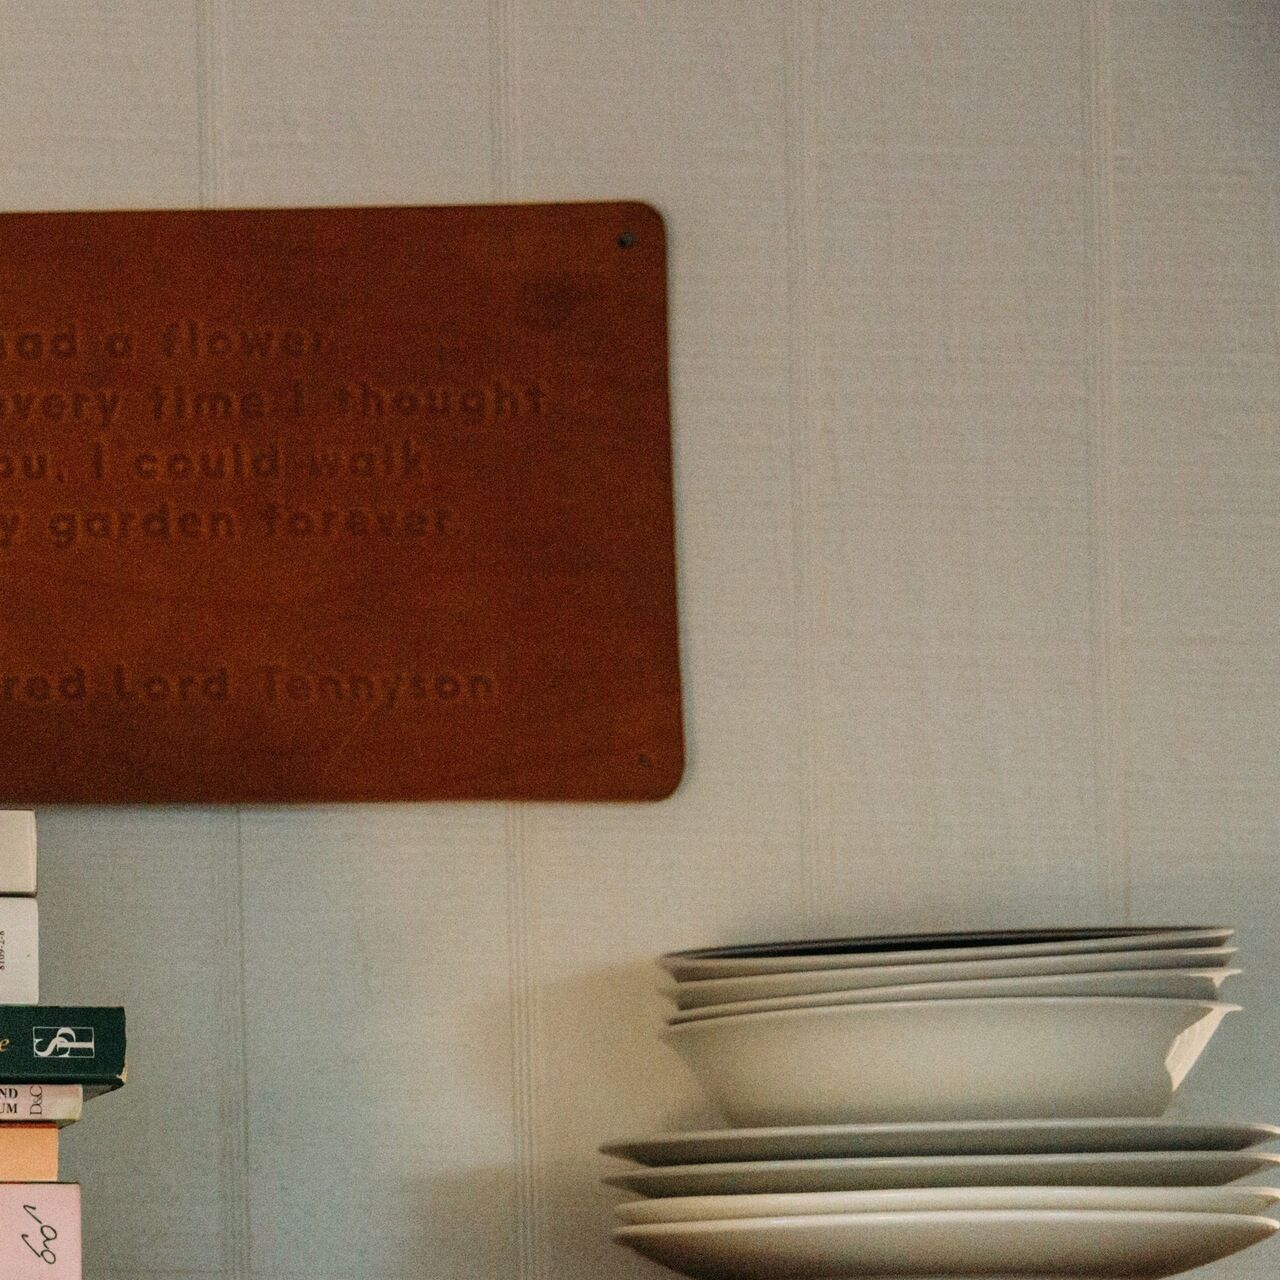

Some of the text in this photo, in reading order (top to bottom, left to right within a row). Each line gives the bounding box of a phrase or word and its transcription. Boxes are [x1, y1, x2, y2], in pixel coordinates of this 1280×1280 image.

[104, 331, 134, 360] a
[161, 319, 325, 360] flower
[149, 384, 266, 421] time
[333, 379, 545, 427] thought
[134, 442, 280, 481] could
[302, 438, 425, 478] walk
[47, 503, 238, 549] garden
[114, 663, 229, 701] Lord
[261, 663, 494, 709] Tennyson
